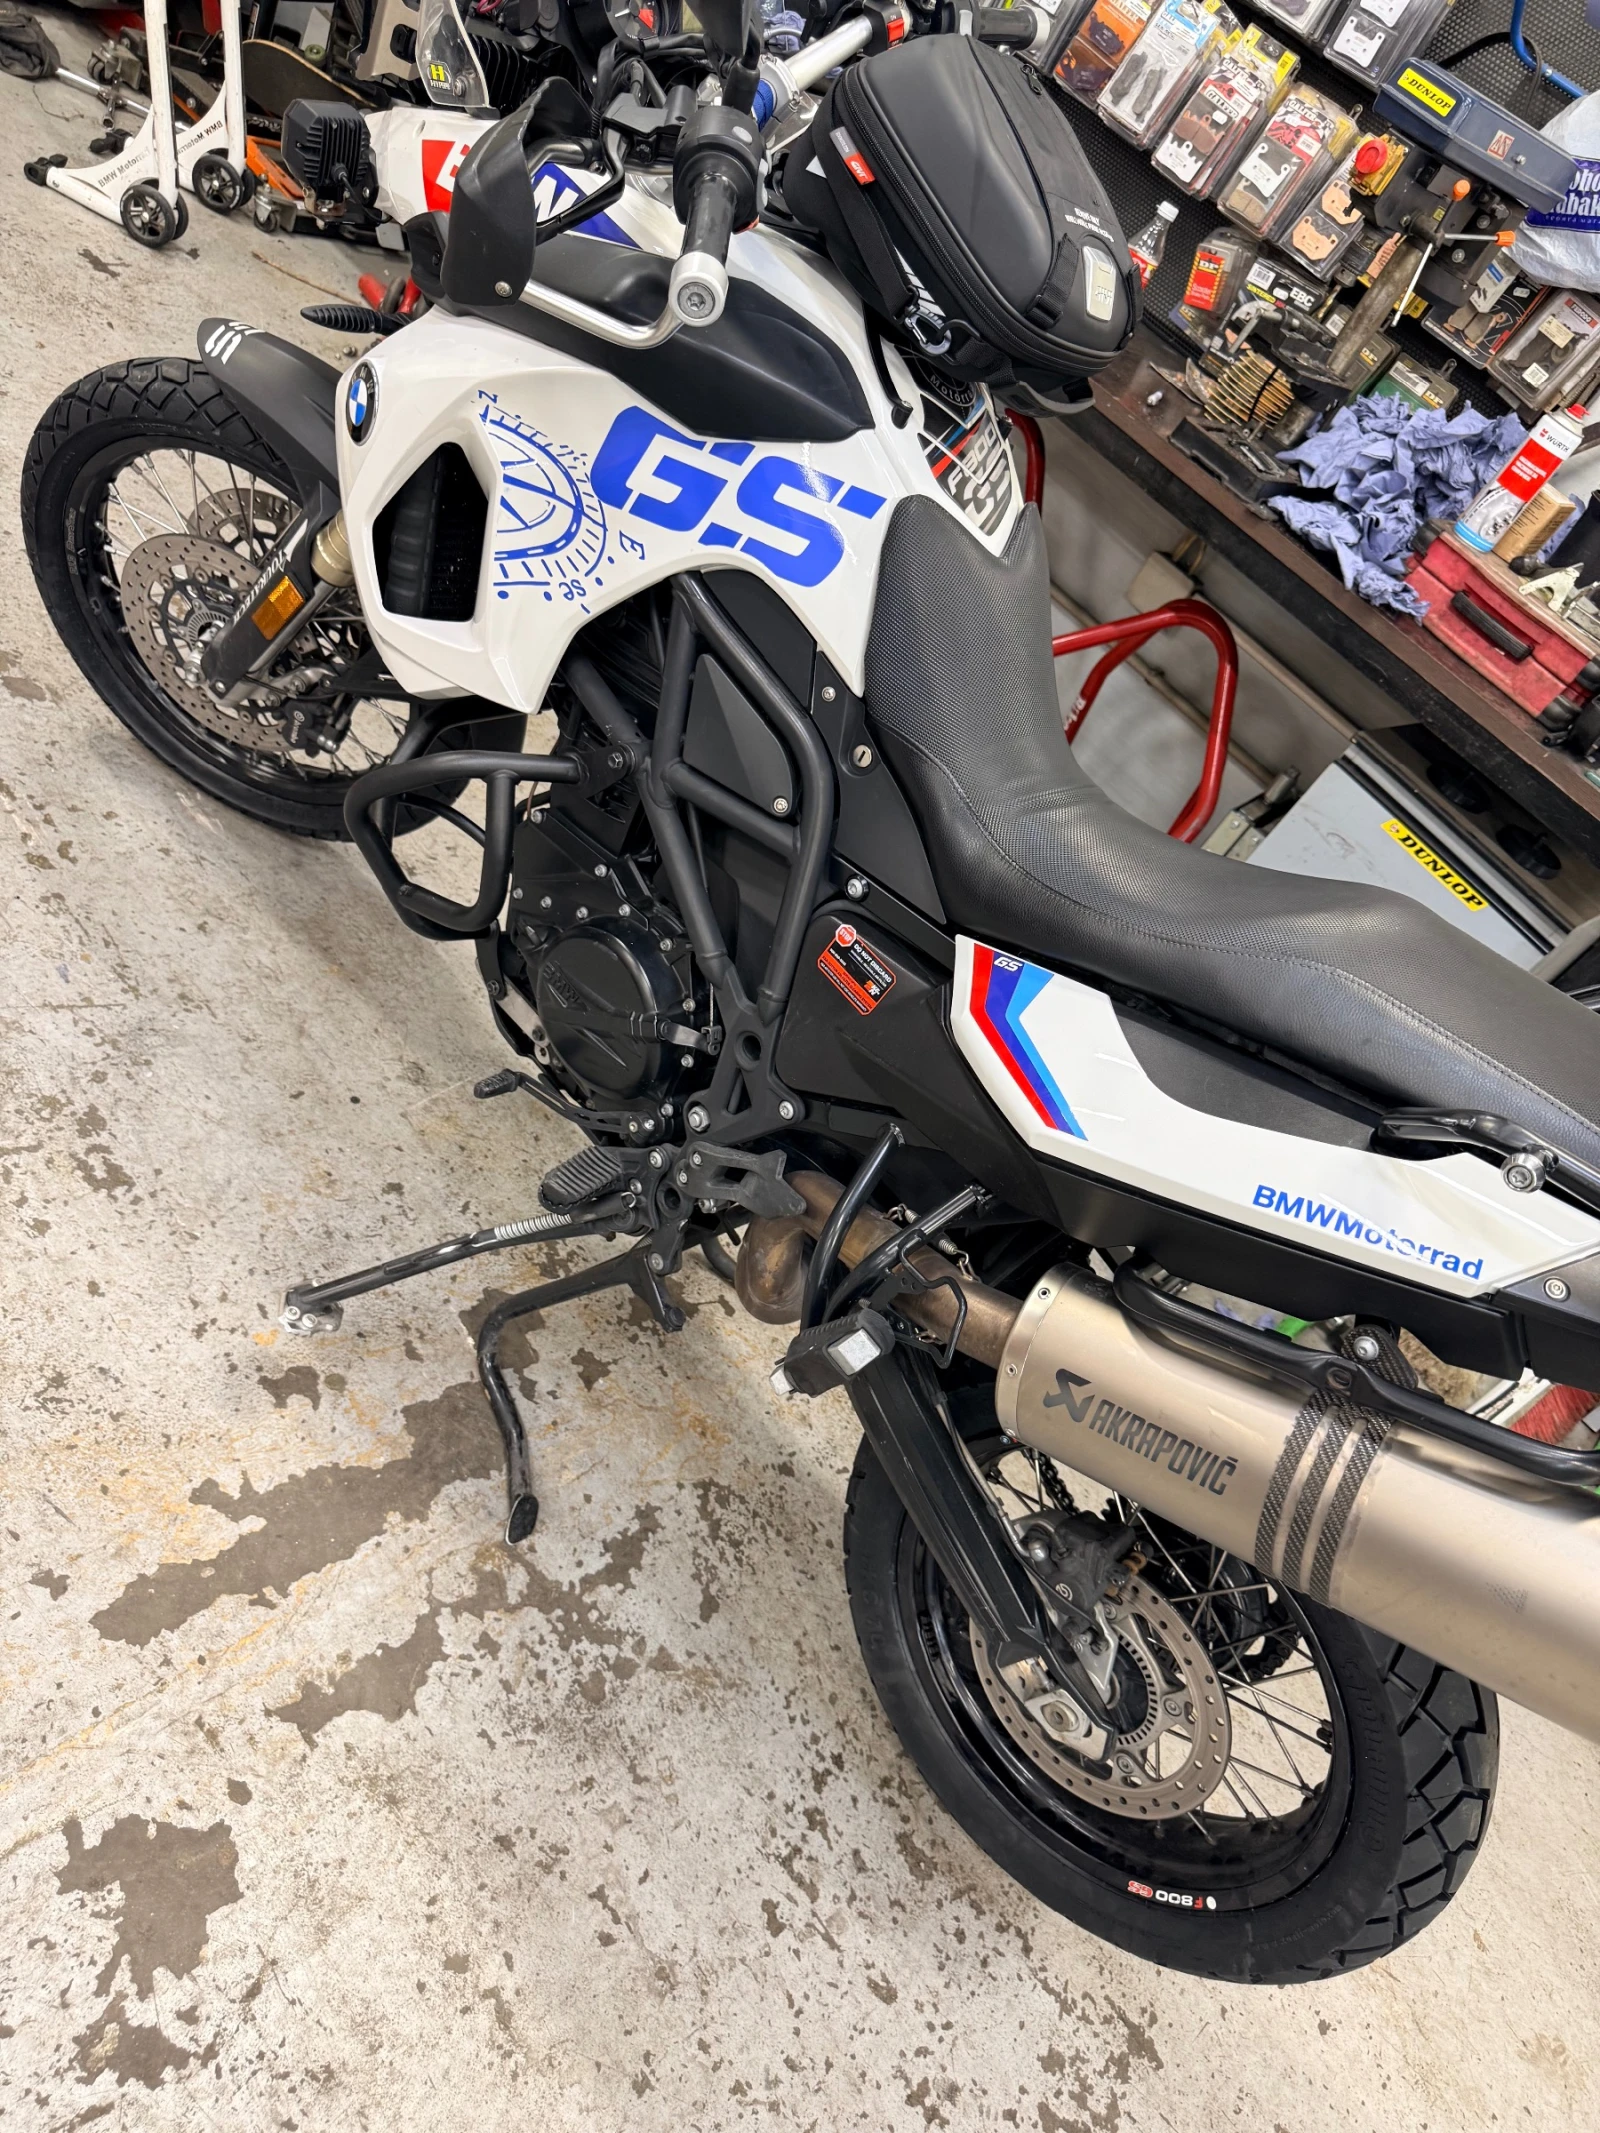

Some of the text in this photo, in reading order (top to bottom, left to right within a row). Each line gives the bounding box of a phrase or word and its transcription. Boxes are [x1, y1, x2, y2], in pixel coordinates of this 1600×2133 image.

[1408, 78, 1451, 110] DUNLOP
[98, 169, 118, 188] BMW
[1290, 287, 1315, 307] EBC
[590, 405, 888, 588] GS
[233, 550, 287, 627] TOURATECH
[1397, 834, 1484, 907] DUNLOP
[839, 928, 853, 942] STOP
[854, 943, 893, 983] DO NOT DISCARD
[993, 955, 1024, 973] GS
[1127, 1880, 1153, 1898] GS
